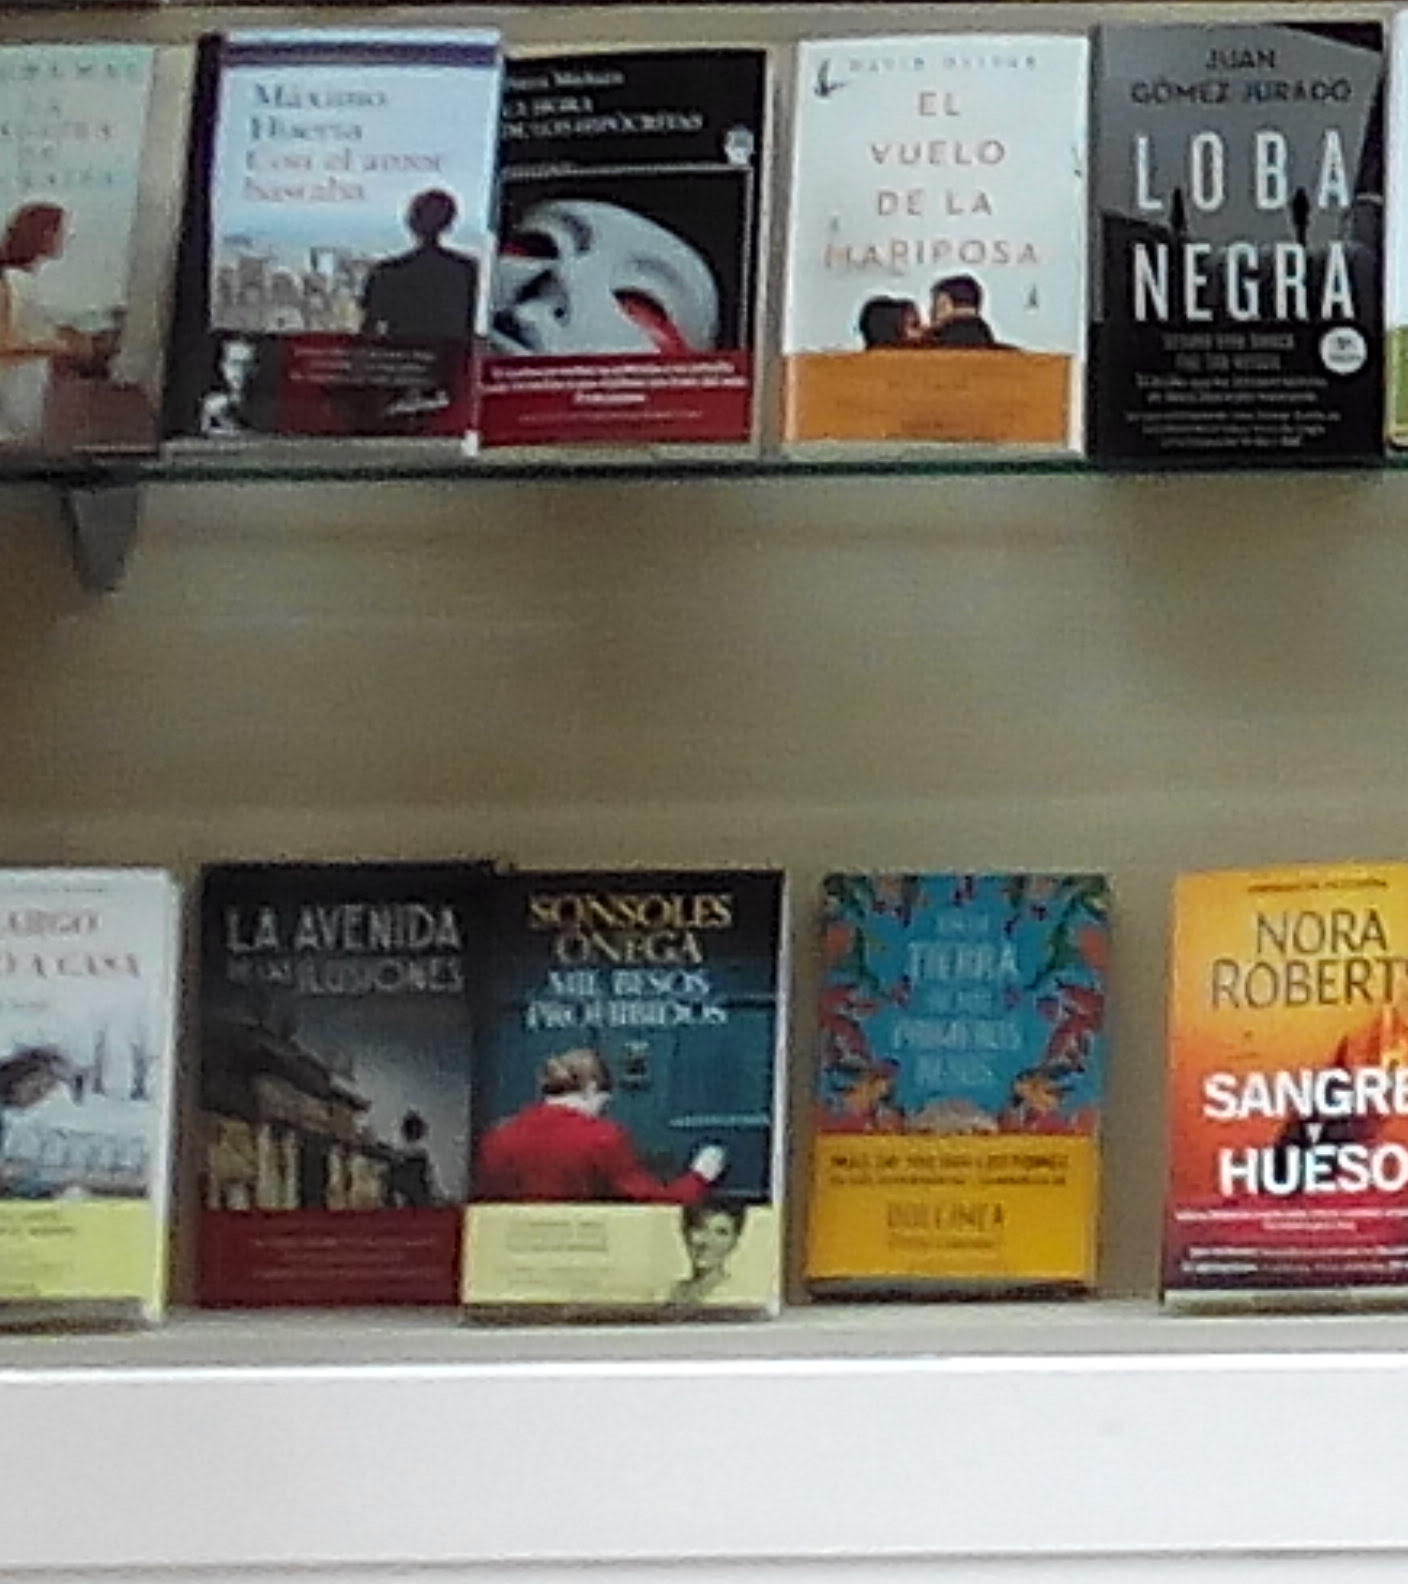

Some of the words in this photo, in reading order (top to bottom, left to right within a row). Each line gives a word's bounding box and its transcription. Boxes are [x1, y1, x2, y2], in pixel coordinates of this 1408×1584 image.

[1205, 48, 1277, 68] JUAN
[918, 92, 962, 118] EL
[868, 138, 1007, 166] VUELO
[1136, 128, 1352, 213] LOBA
[876, 188, 925, 218] DE
[945, 189, 994, 218] LA
[823, 236, 1040, 270] MARIPOSA
[1133, 240, 1357, 323] NEGRA
[226, 905, 282, 954] LA
[296, 902, 462, 951] AVENIDA
[528, 892, 734, 930] SONSOLES
[1255, 906, 1390, 957] NORA
